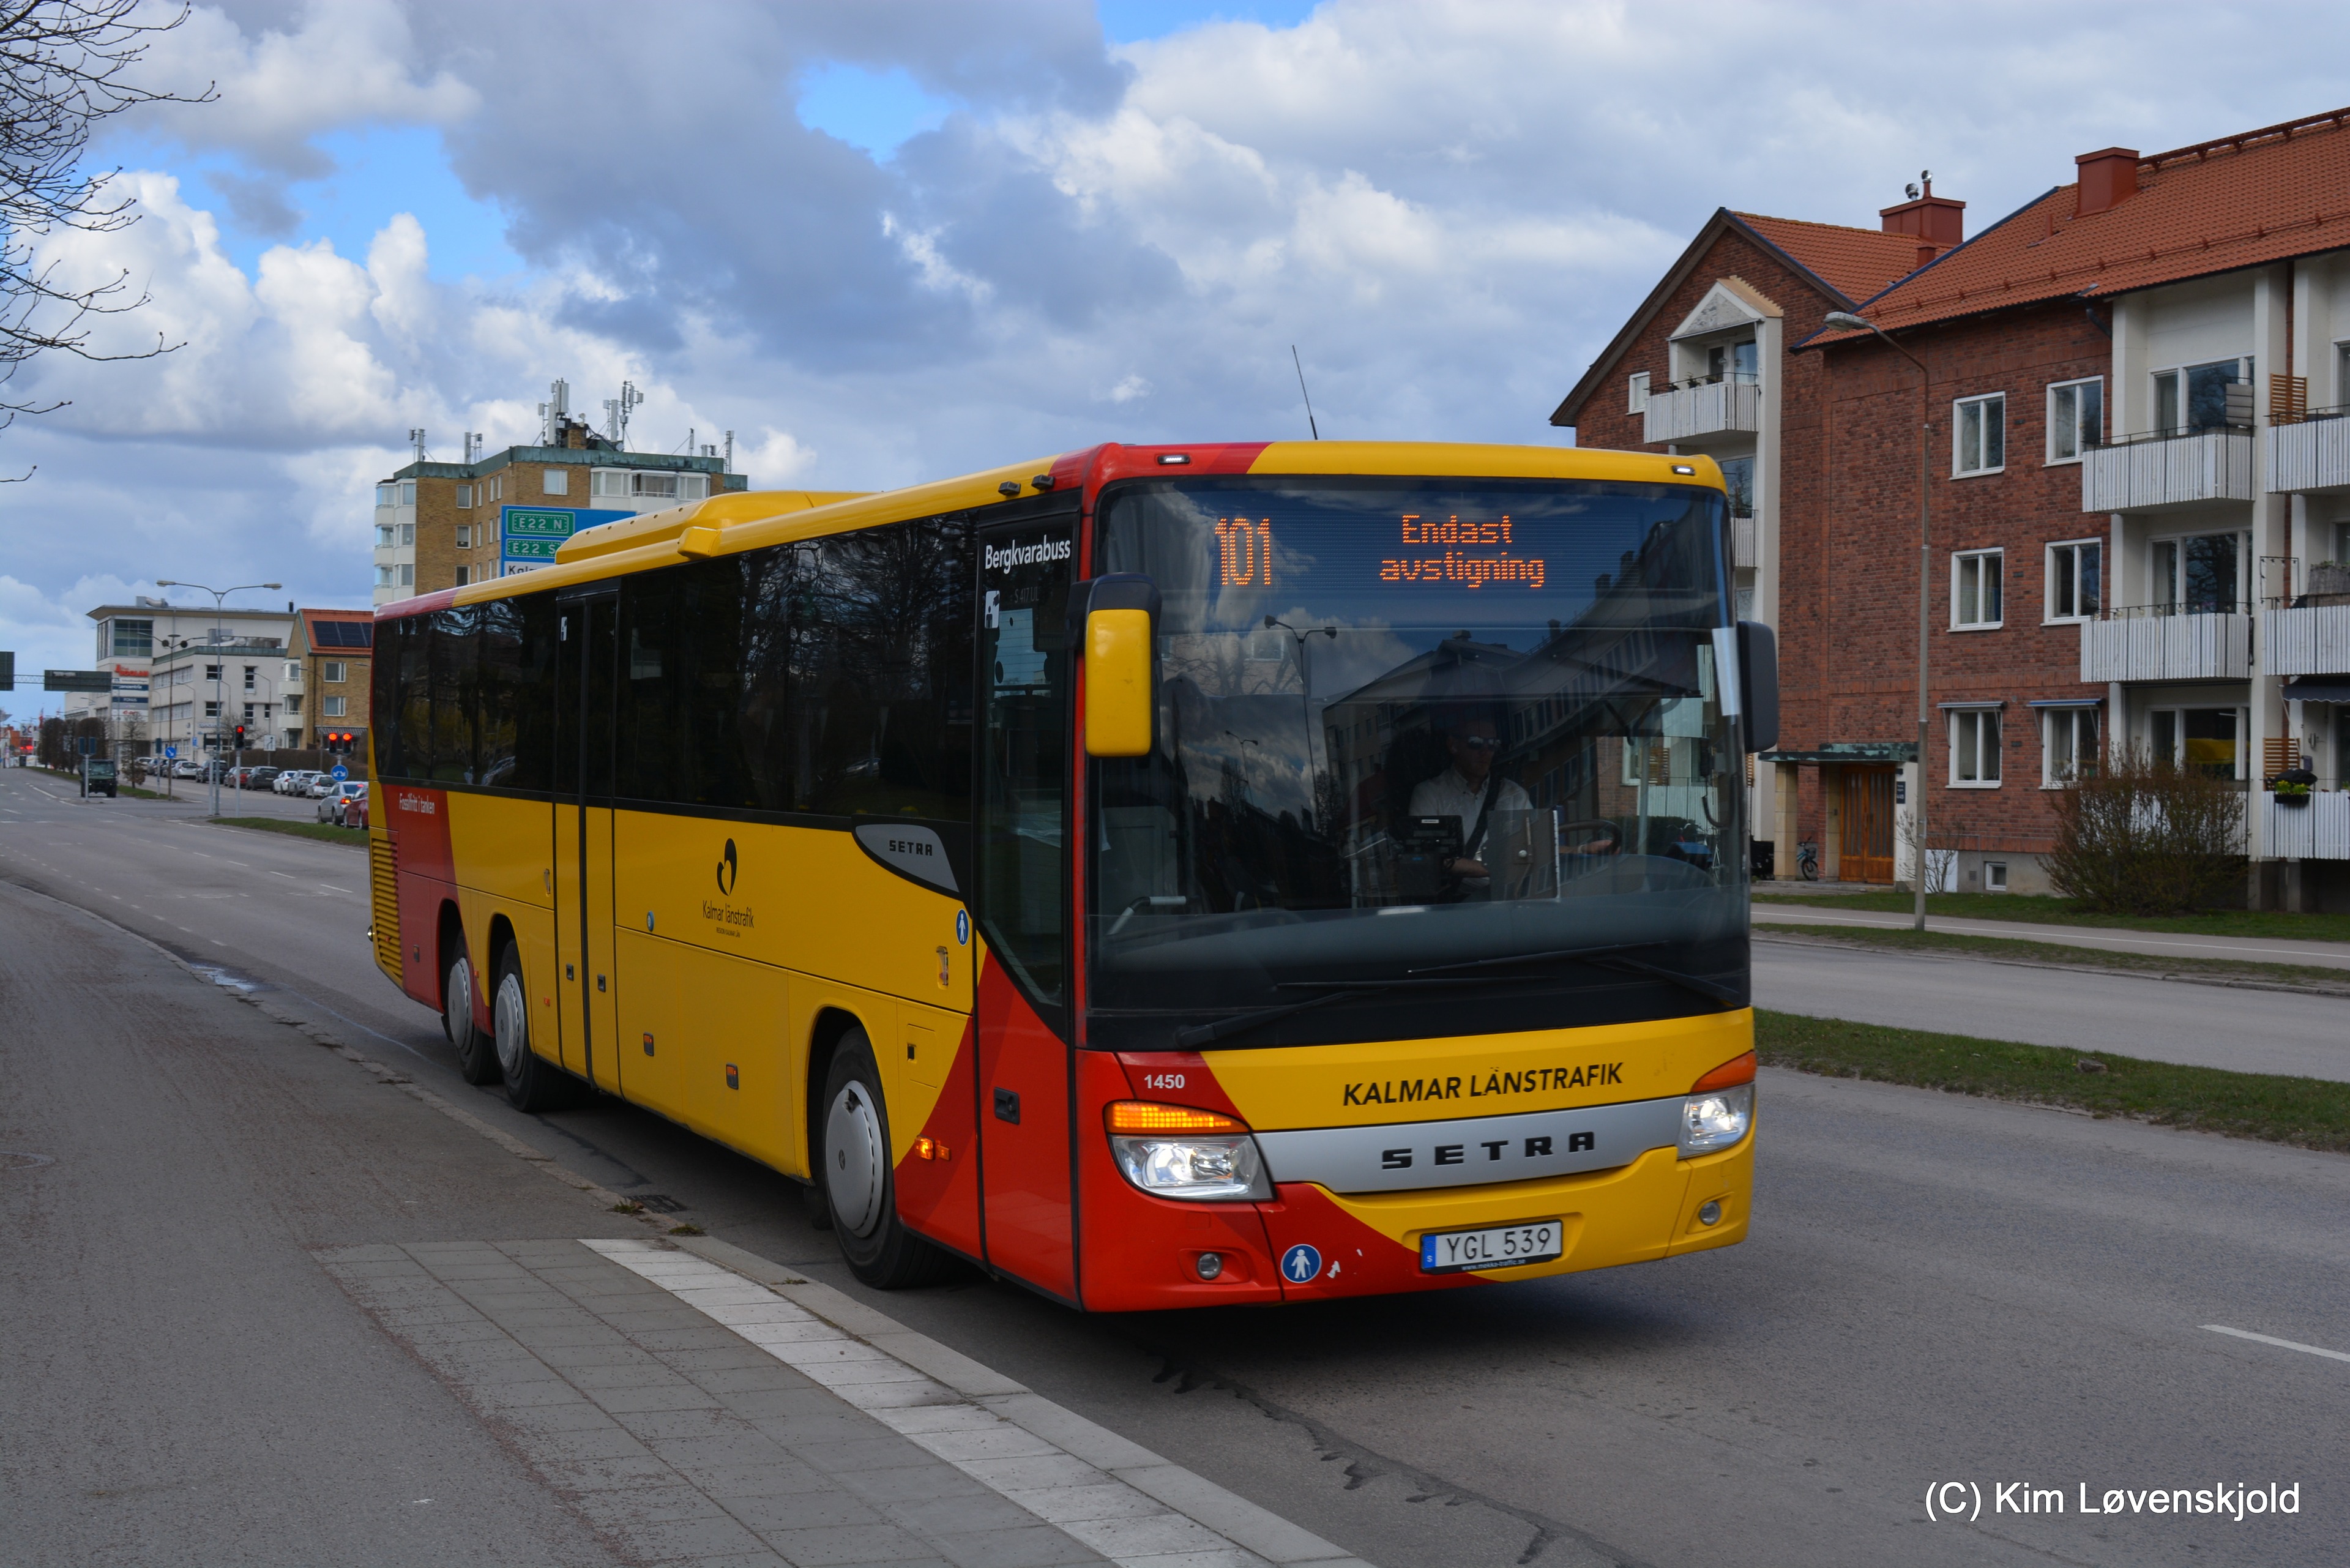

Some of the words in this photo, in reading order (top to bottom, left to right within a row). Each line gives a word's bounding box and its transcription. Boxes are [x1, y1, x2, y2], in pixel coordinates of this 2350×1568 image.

[519, 517, 546, 529] E22
[554, 519, 562, 529] N
[1403, 515, 1512, 543] Endast
[513, 542, 539, 553] E22
[548, 544, 556, 554] S
[985, 534, 1070, 574] Bergkvarabuss
[1215, 518, 1271, 586] 101
[1379, 551, 1544, 588] avstigning
[889, 840, 932, 856] SETRA
[703, 900, 723, 922] Kalmar
[725, 903, 755, 928] länstrafik
[1144, 1074, 1185, 1089] 1450
[1343, 1077, 1461, 1106] KALMAR
[1382, 1131, 1595, 1170] SETRA
[1446, 1234, 1493, 1263] YGL
[1504, 1227, 1551, 1256] 539
